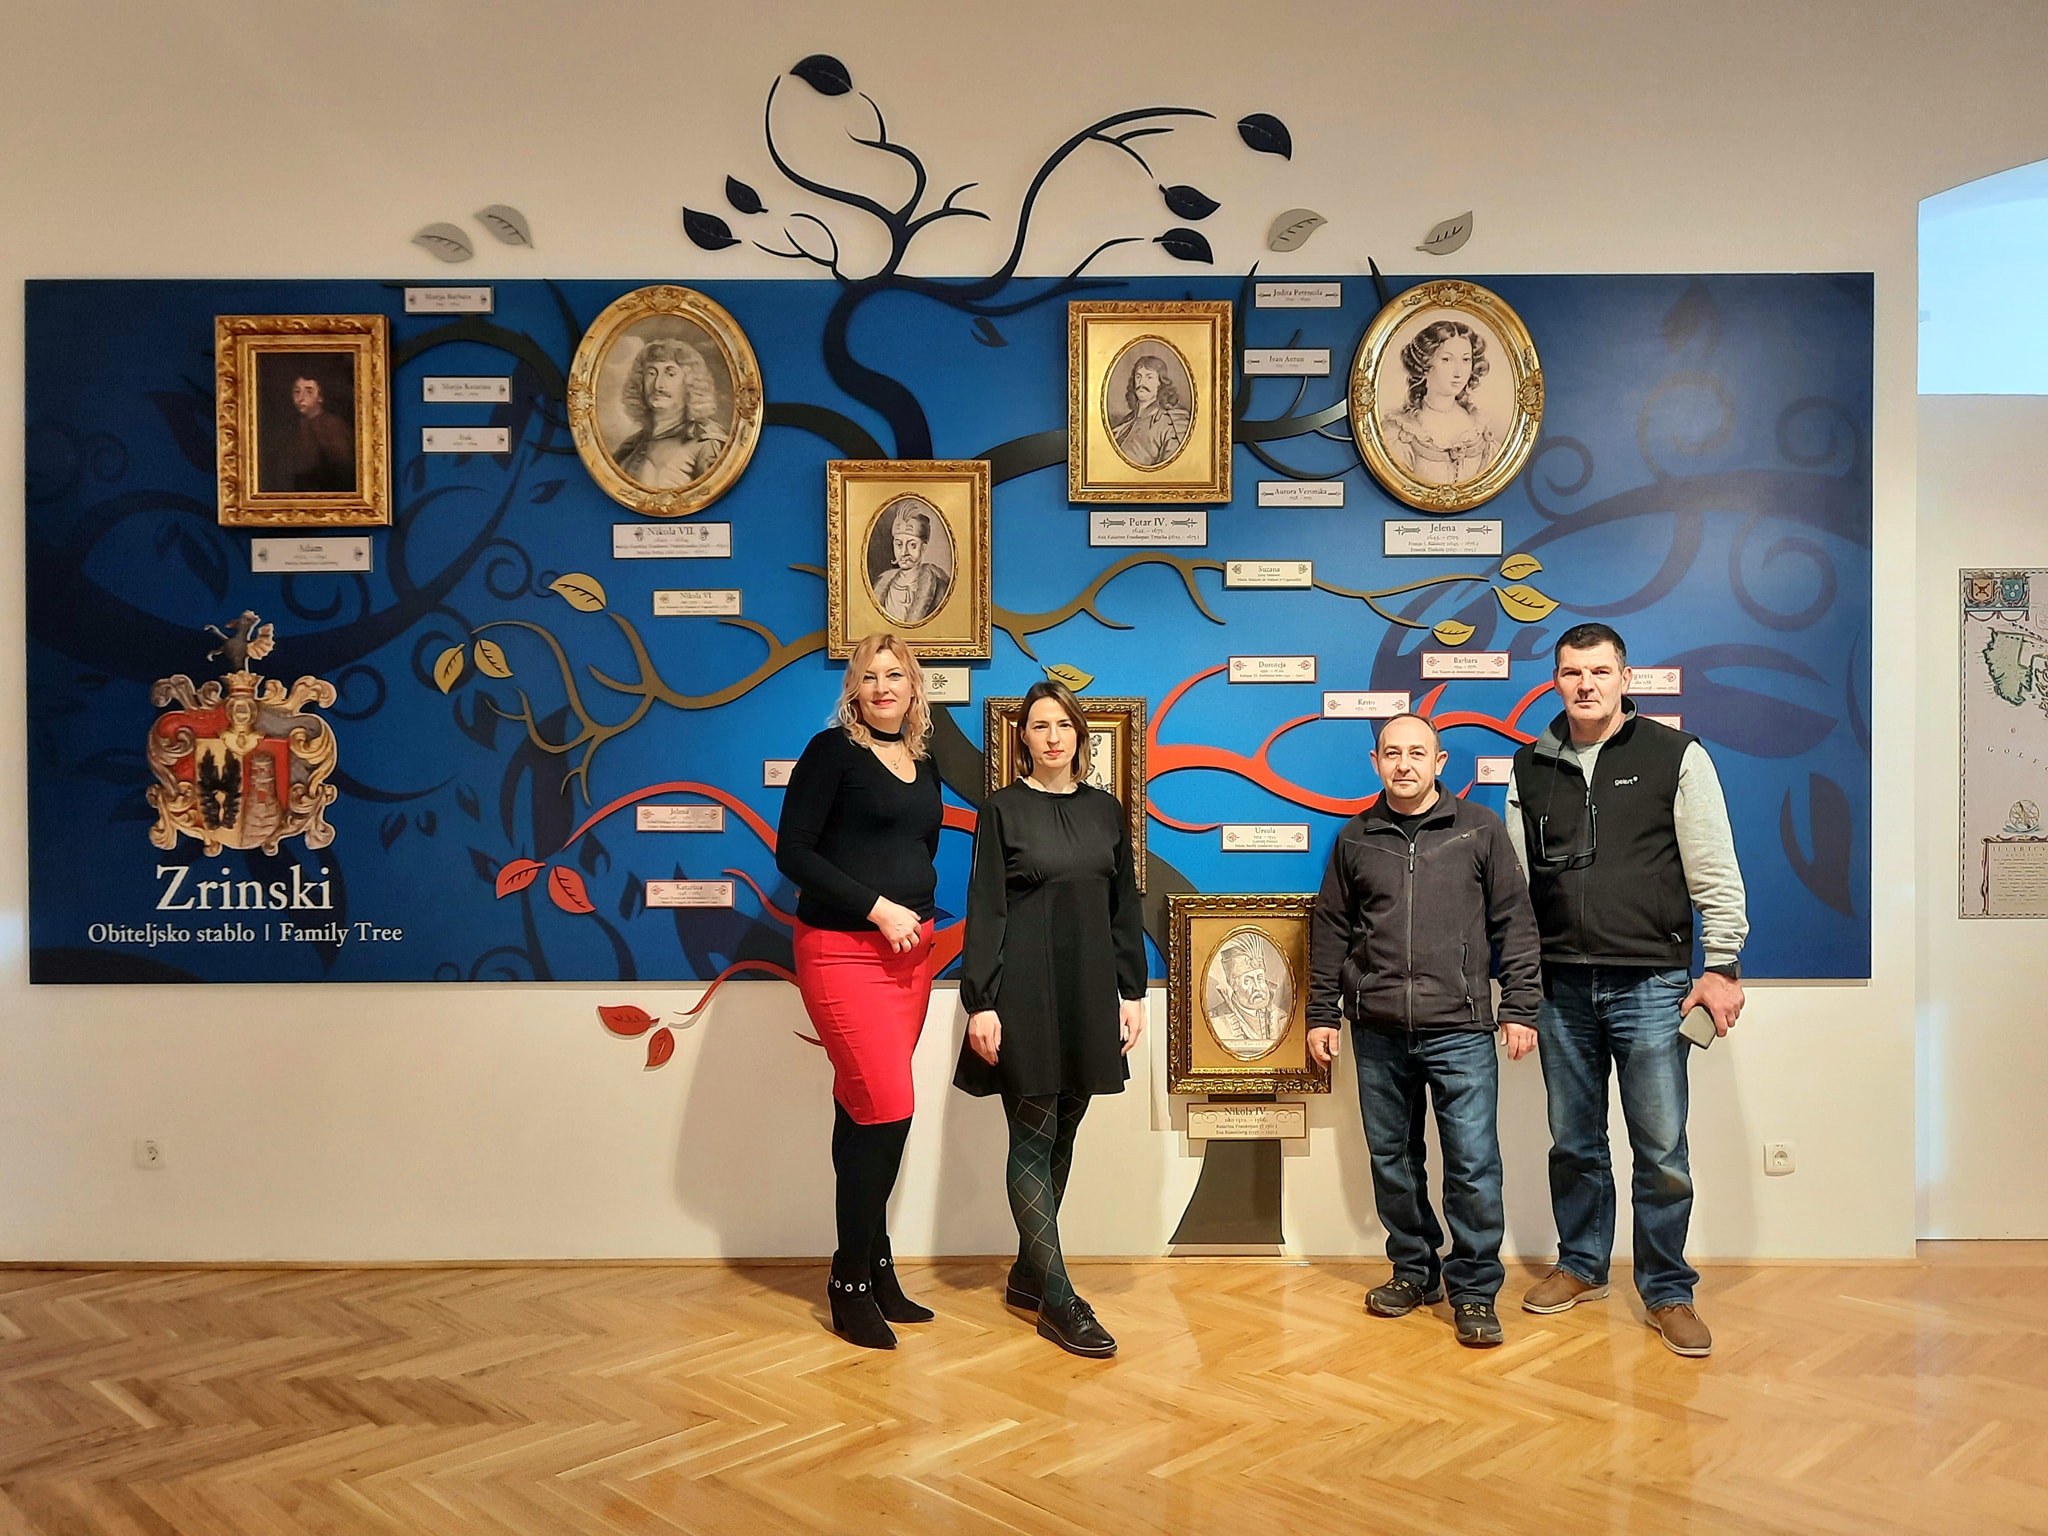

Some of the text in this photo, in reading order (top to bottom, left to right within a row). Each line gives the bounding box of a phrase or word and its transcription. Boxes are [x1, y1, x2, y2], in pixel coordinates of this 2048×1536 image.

[1269, 355, 1283, 363] Ivan
[647, 526, 676, 536] Nikola
[1430, 523, 1456, 534] Jelena
[1257, 565, 1281, 573] Suzana
[1453, 656, 1478, 664] Barbara
[155, 863, 334, 911] Zrinski
[87, 922, 191, 947] Obiteljsko
[196, 922, 256, 942] stablo
[279, 922, 349, 947] Family
[353, 922, 404, 942] Tree
[1224, 1106, 1254, 1116] Nikola
